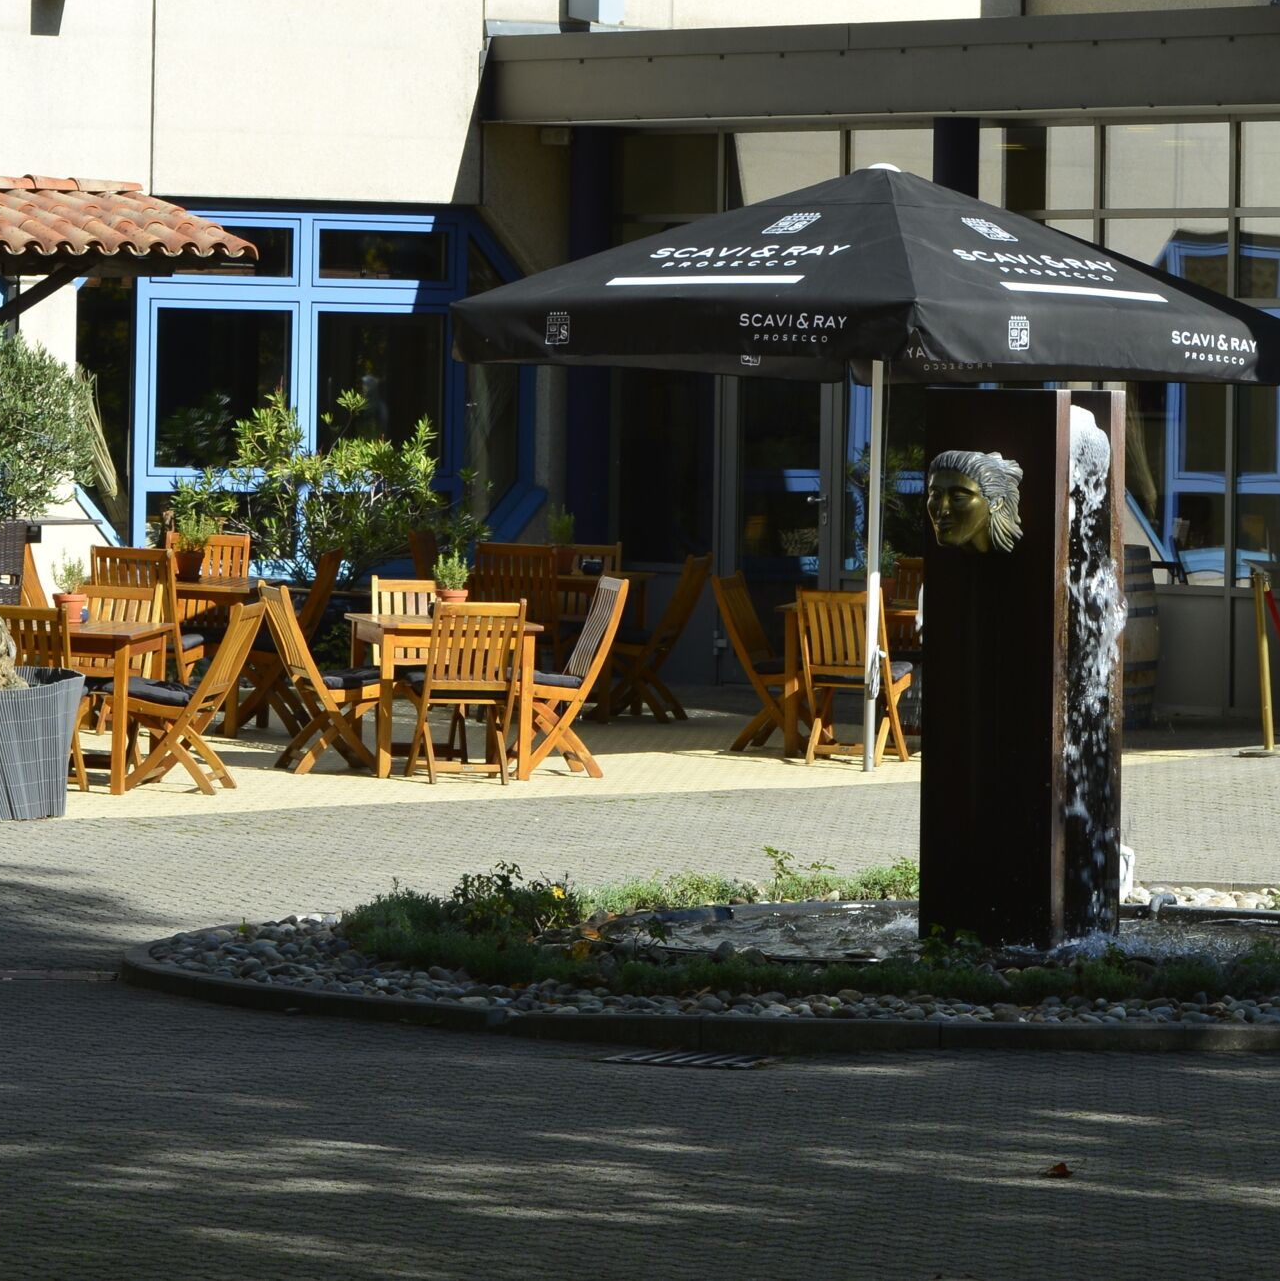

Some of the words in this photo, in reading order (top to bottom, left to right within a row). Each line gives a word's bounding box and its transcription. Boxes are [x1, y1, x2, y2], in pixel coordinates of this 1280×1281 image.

[661, 259, 797, 269] PROSECCO
[753, 333, 829, 343] PROSECCO
[1184, 351, 1246, 366] PROSECCO
